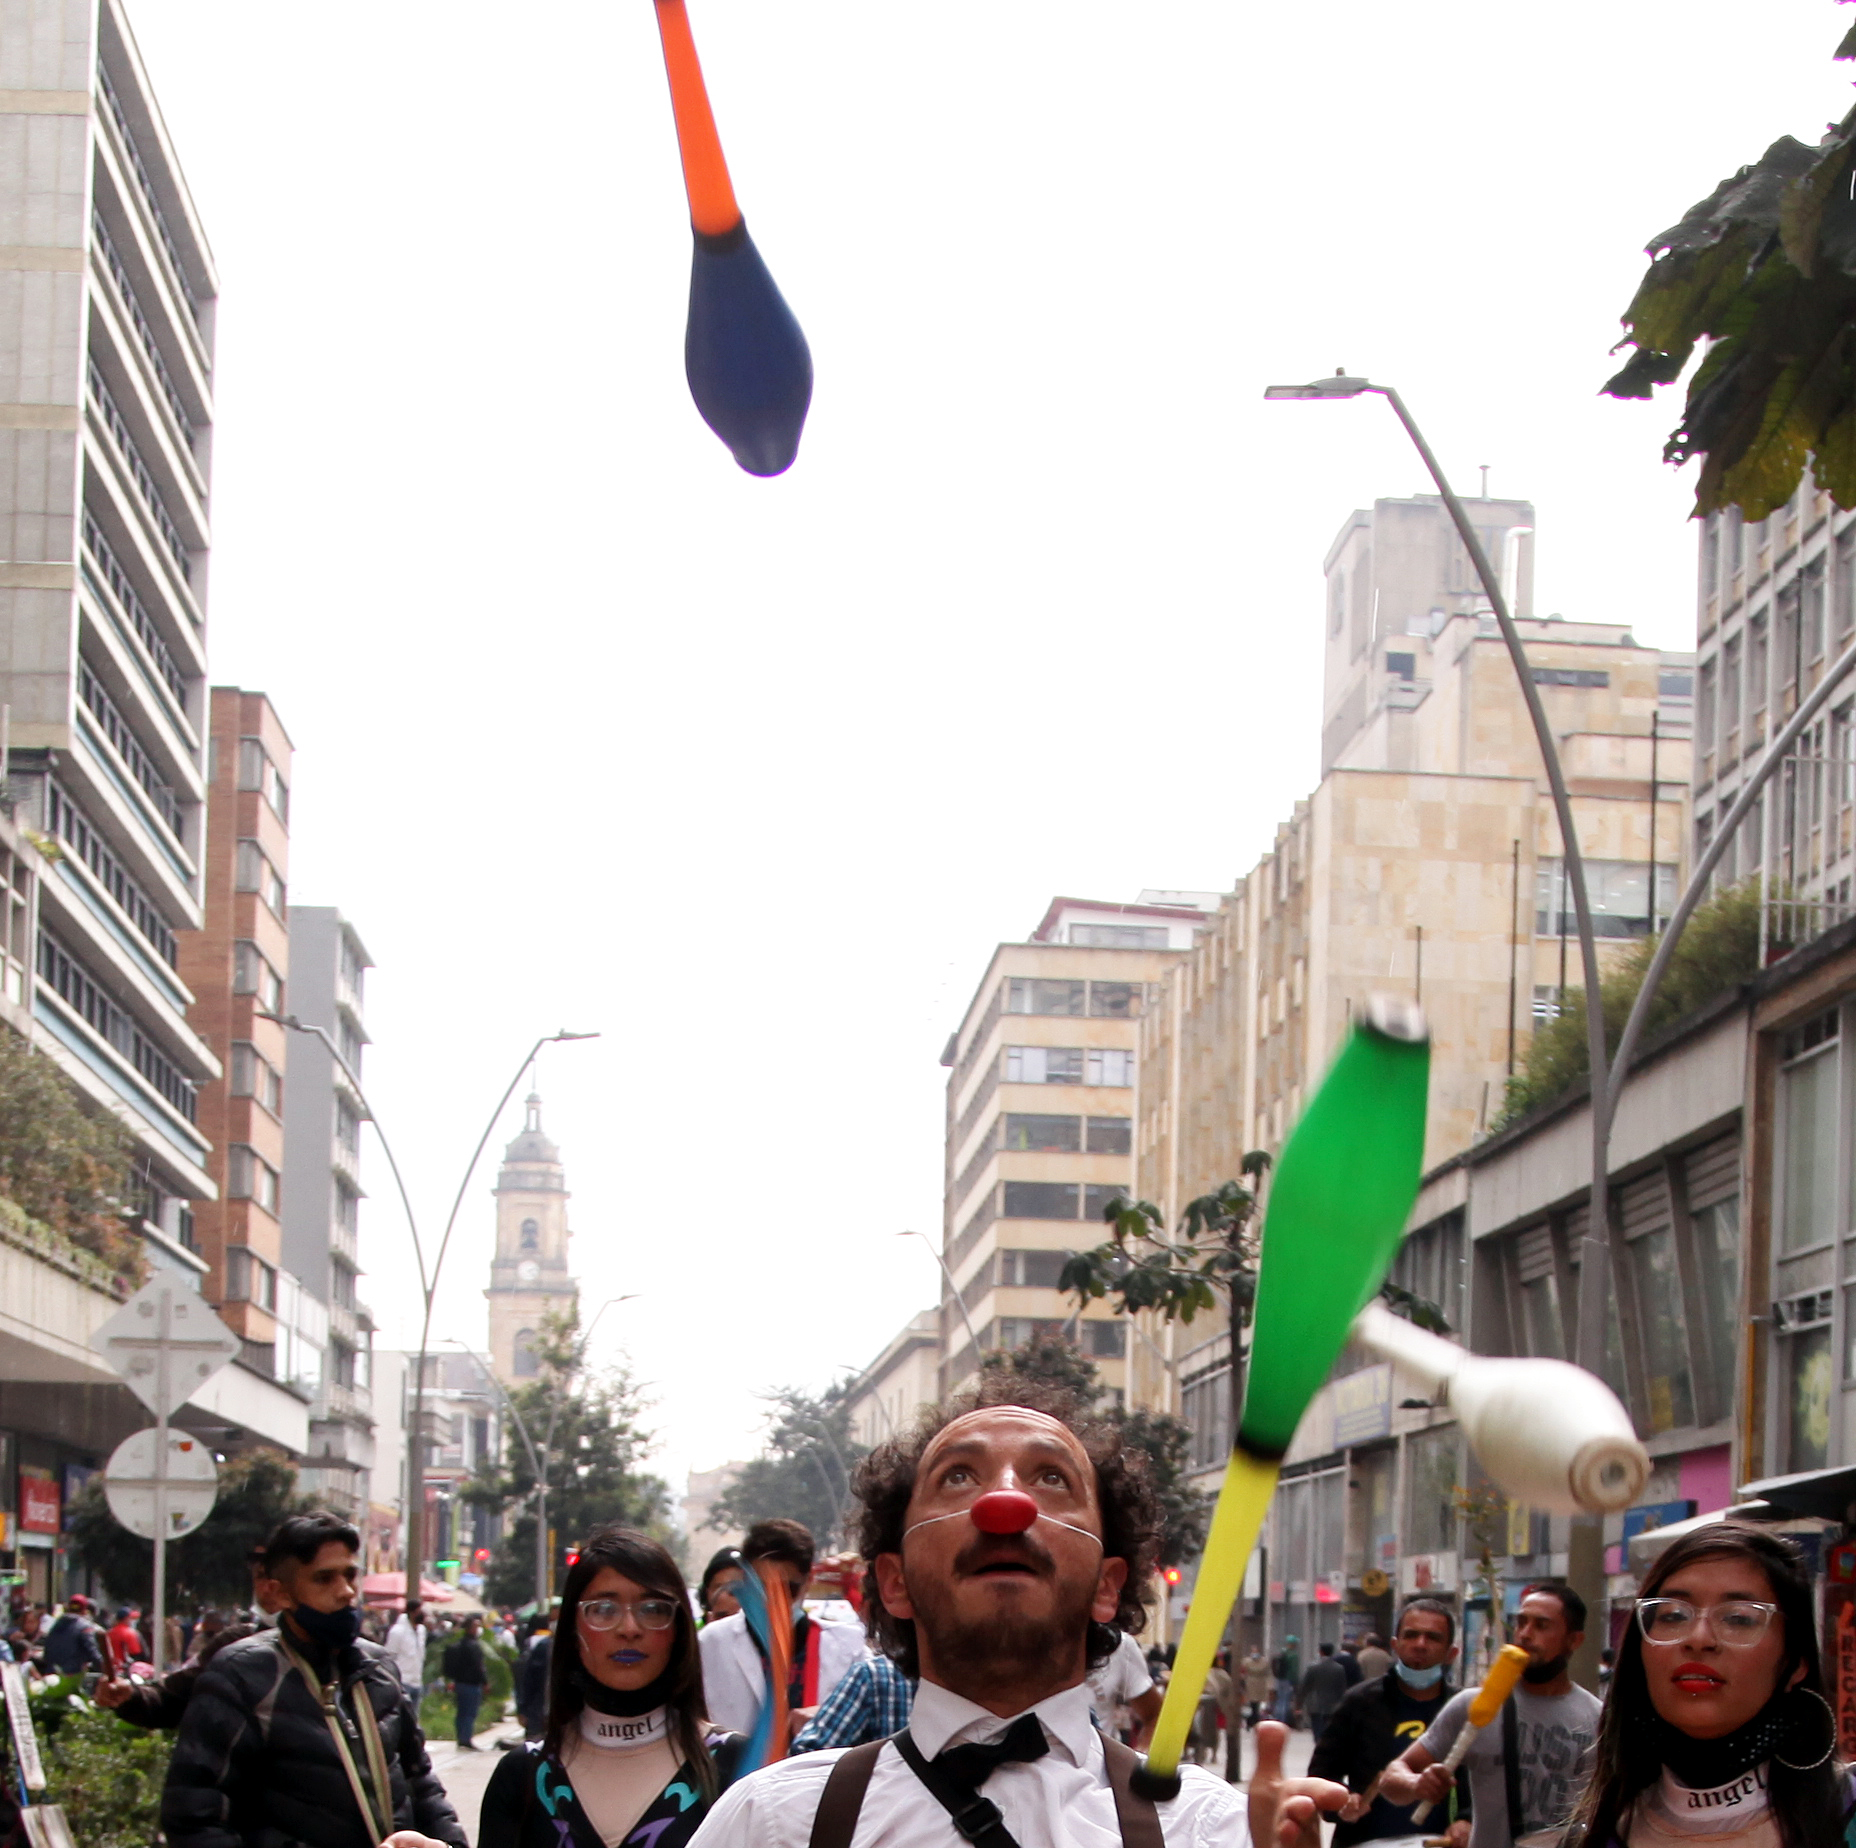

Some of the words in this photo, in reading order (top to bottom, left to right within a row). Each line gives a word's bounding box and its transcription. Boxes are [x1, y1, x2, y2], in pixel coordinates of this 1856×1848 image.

[597, 1716, 654, 1741] angel
[1516, 1721, 1593, 1775] UST
[1687, 1767, 1767, 1808] angel
